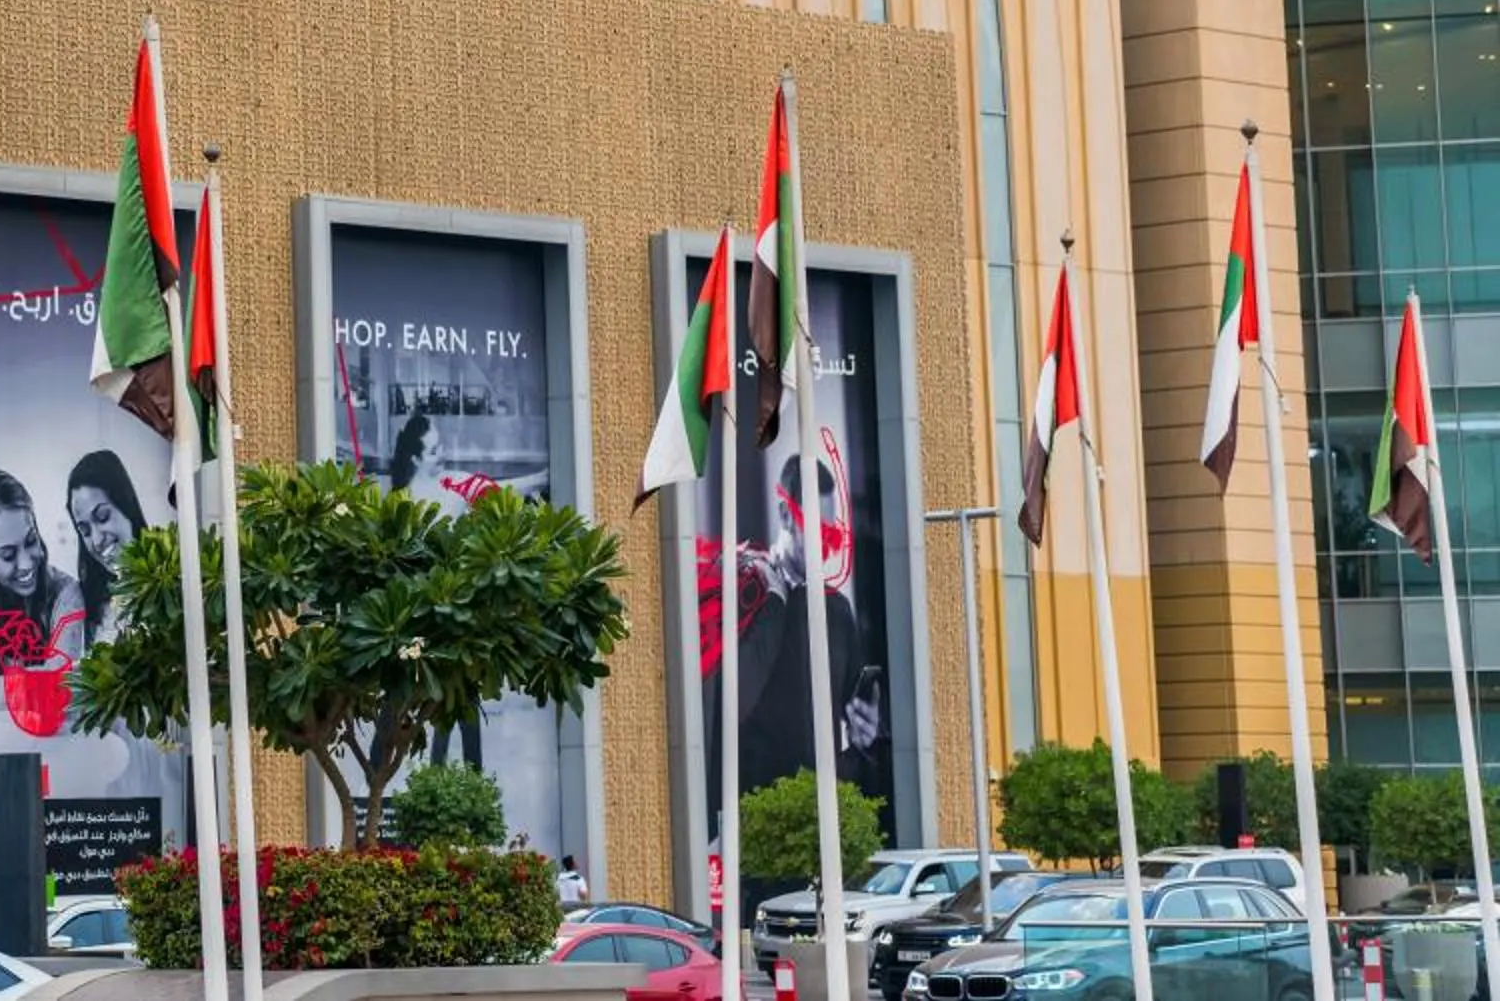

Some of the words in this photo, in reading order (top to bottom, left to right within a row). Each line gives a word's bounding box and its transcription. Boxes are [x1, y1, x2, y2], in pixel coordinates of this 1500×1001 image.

[335, 318, 392, 349] HOP.
[402, 322, 476, 356] EARN.
[485, 330, 528, 360] FLY.
